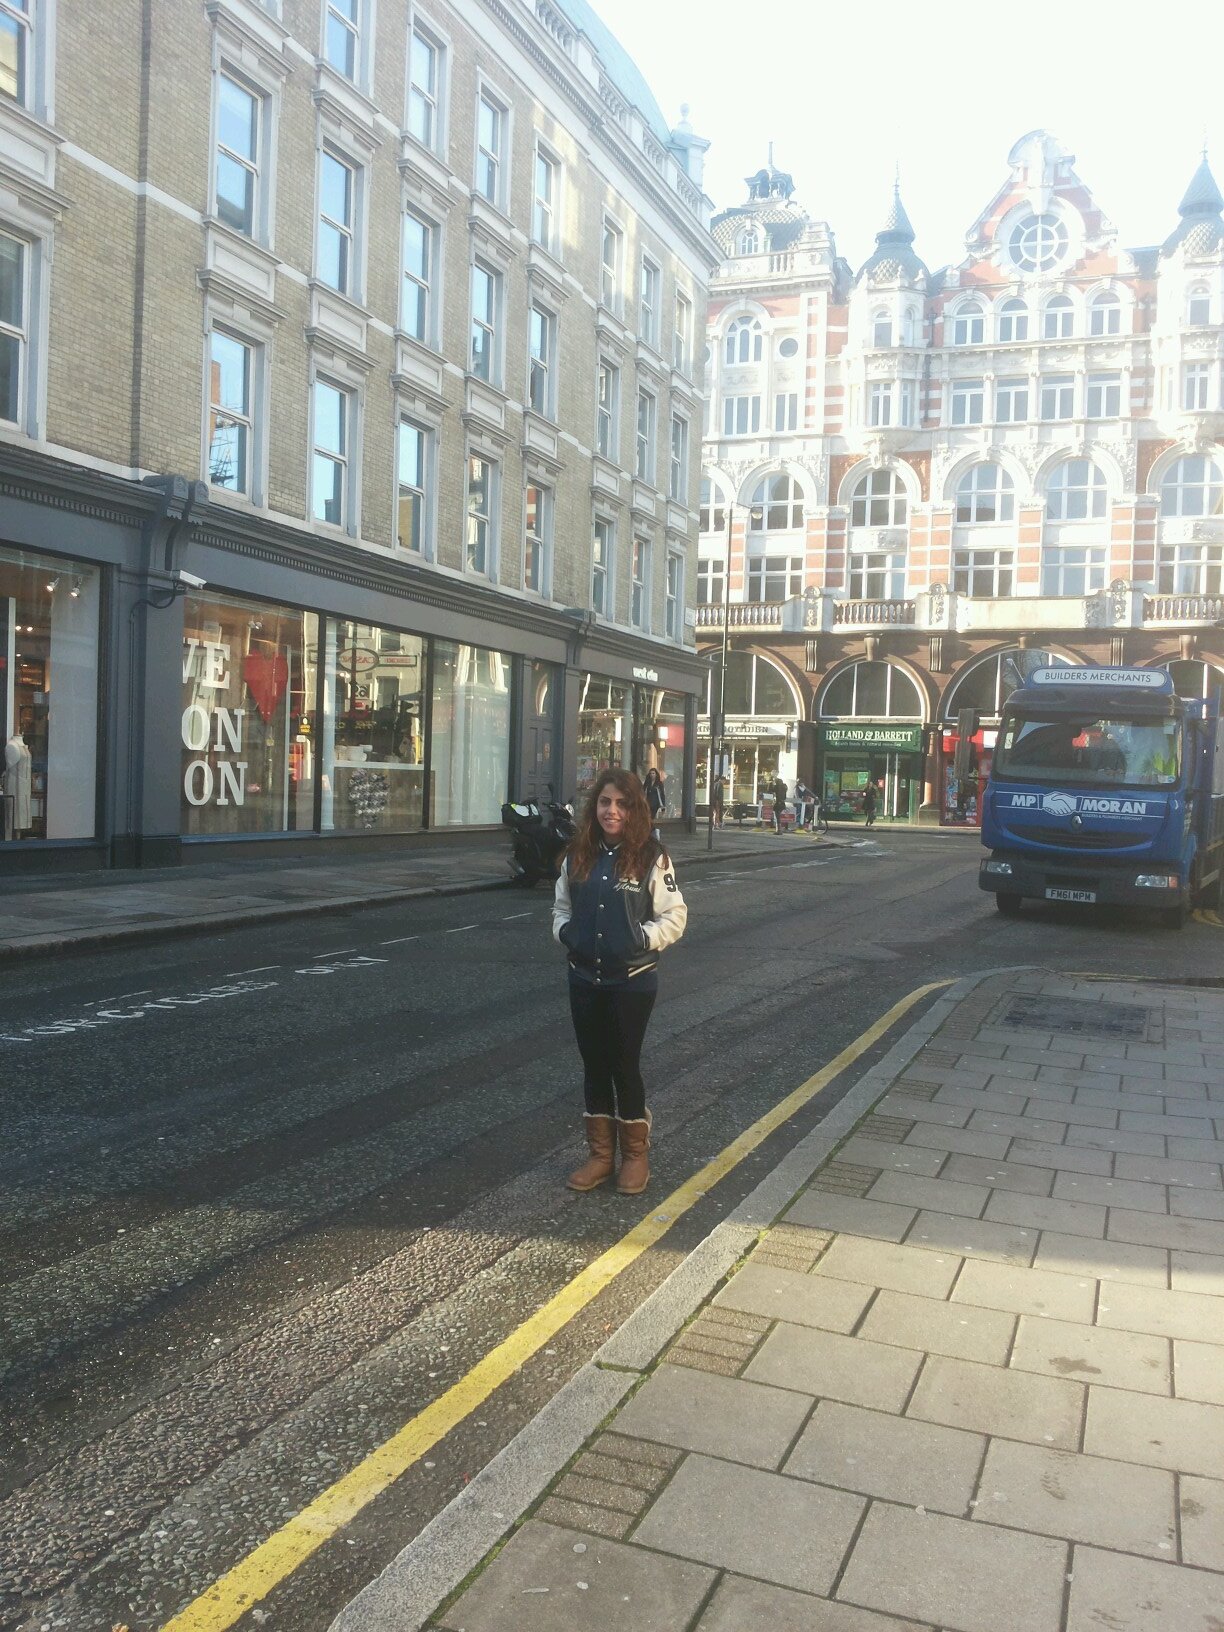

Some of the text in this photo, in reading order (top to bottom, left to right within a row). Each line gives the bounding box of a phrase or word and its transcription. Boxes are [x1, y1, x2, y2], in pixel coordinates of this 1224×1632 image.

[1044, 672, 1152, 683] BUILDERS MERCHANTS
[181, 704, 246, 753] ON
[825, 730, 913, 742] HOLLAND & BARRETT
[184, 760, 249, 806] ON
[1011, 794, 1147, 815] MP MORAN
[663, 873, 677, 892] 9
[1072, 891, 1091, 901] MPM
[294, 955, 390, 975] ONLY
